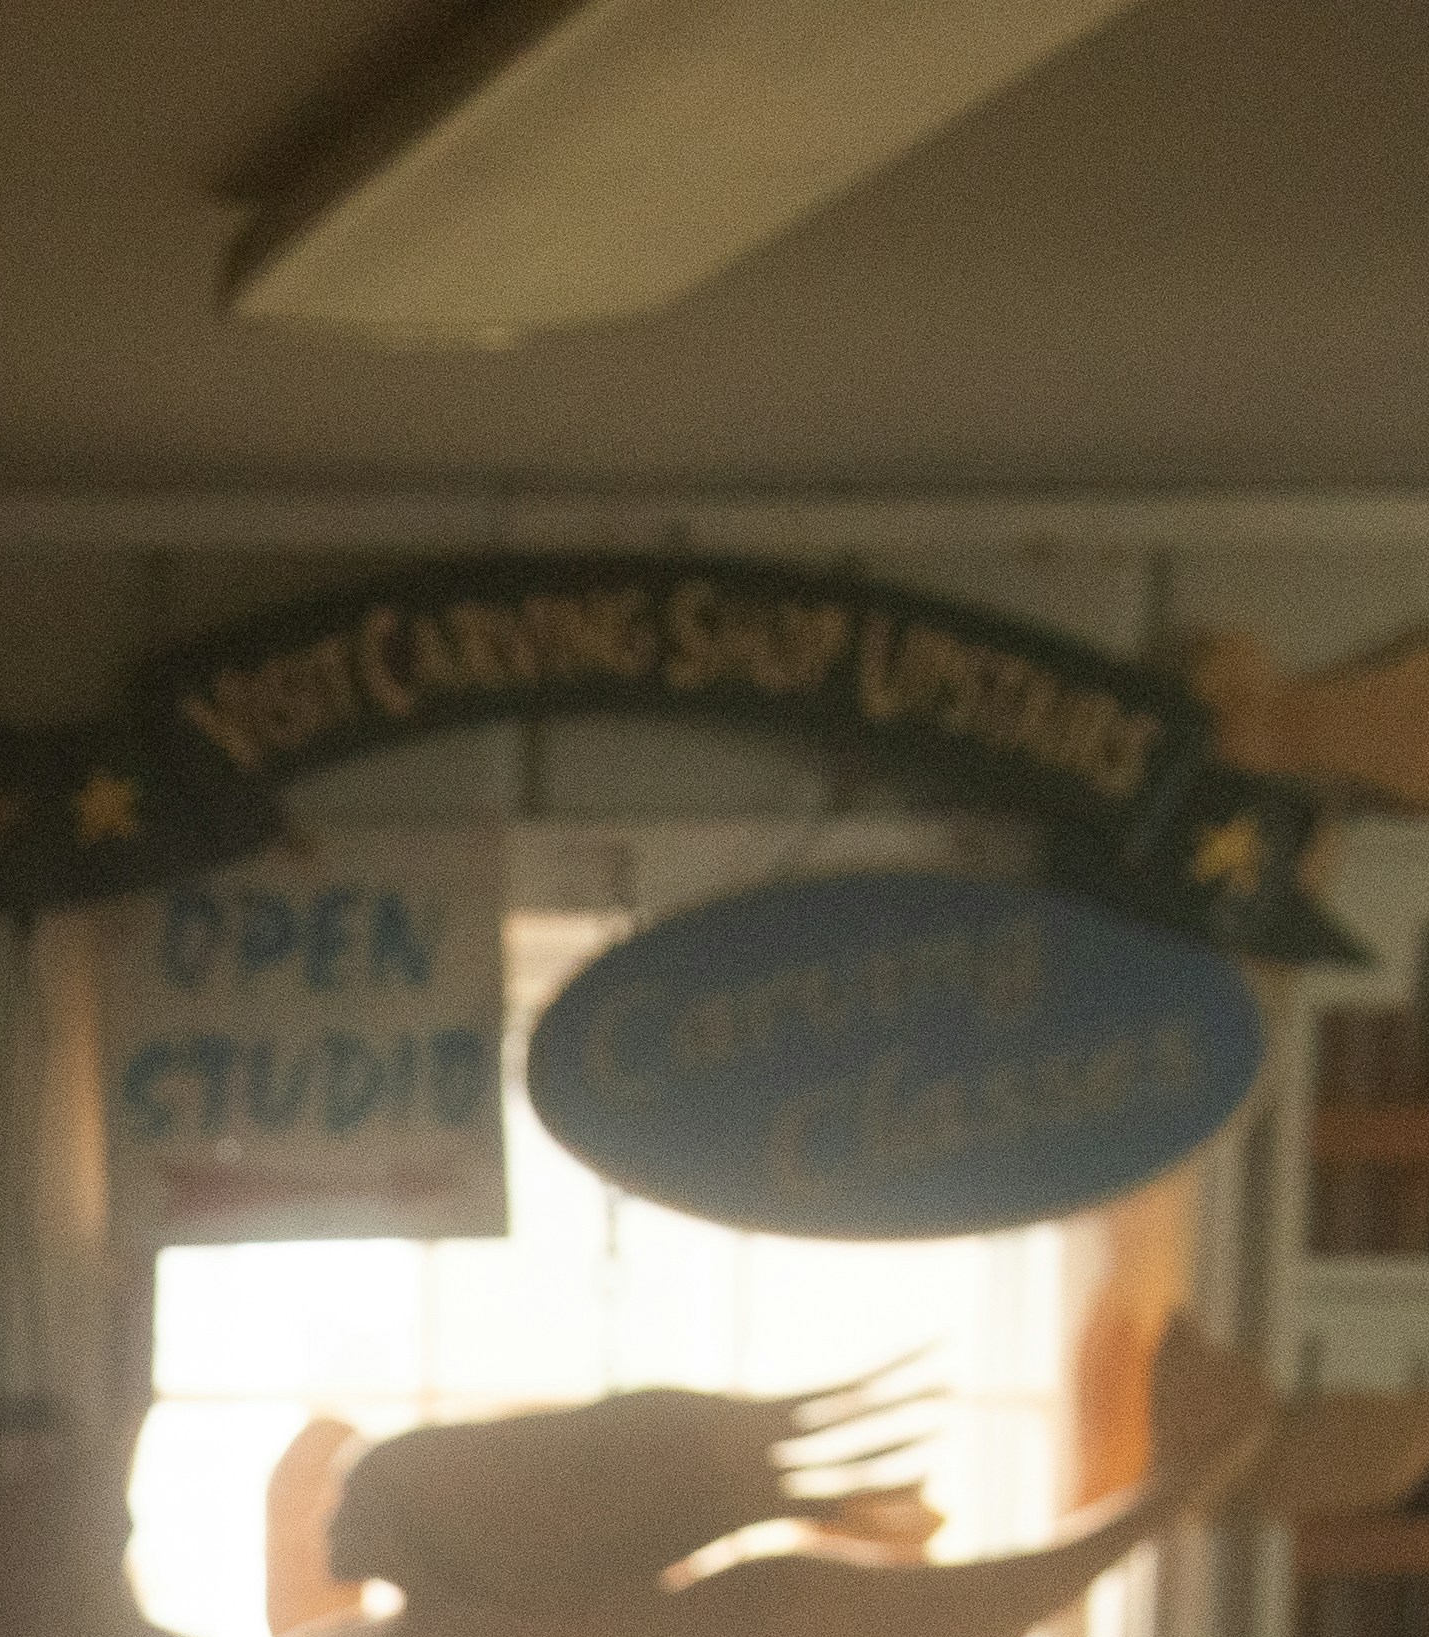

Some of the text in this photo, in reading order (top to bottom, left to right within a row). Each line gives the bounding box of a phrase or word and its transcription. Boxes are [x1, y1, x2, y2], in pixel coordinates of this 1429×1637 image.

[358, 588, 656, 718] CARVING
[664, 580, 852, 694] SHOP
[159, 884, 447, 998] OPEN
[121, 1026, 492, 1140] STUDIO
